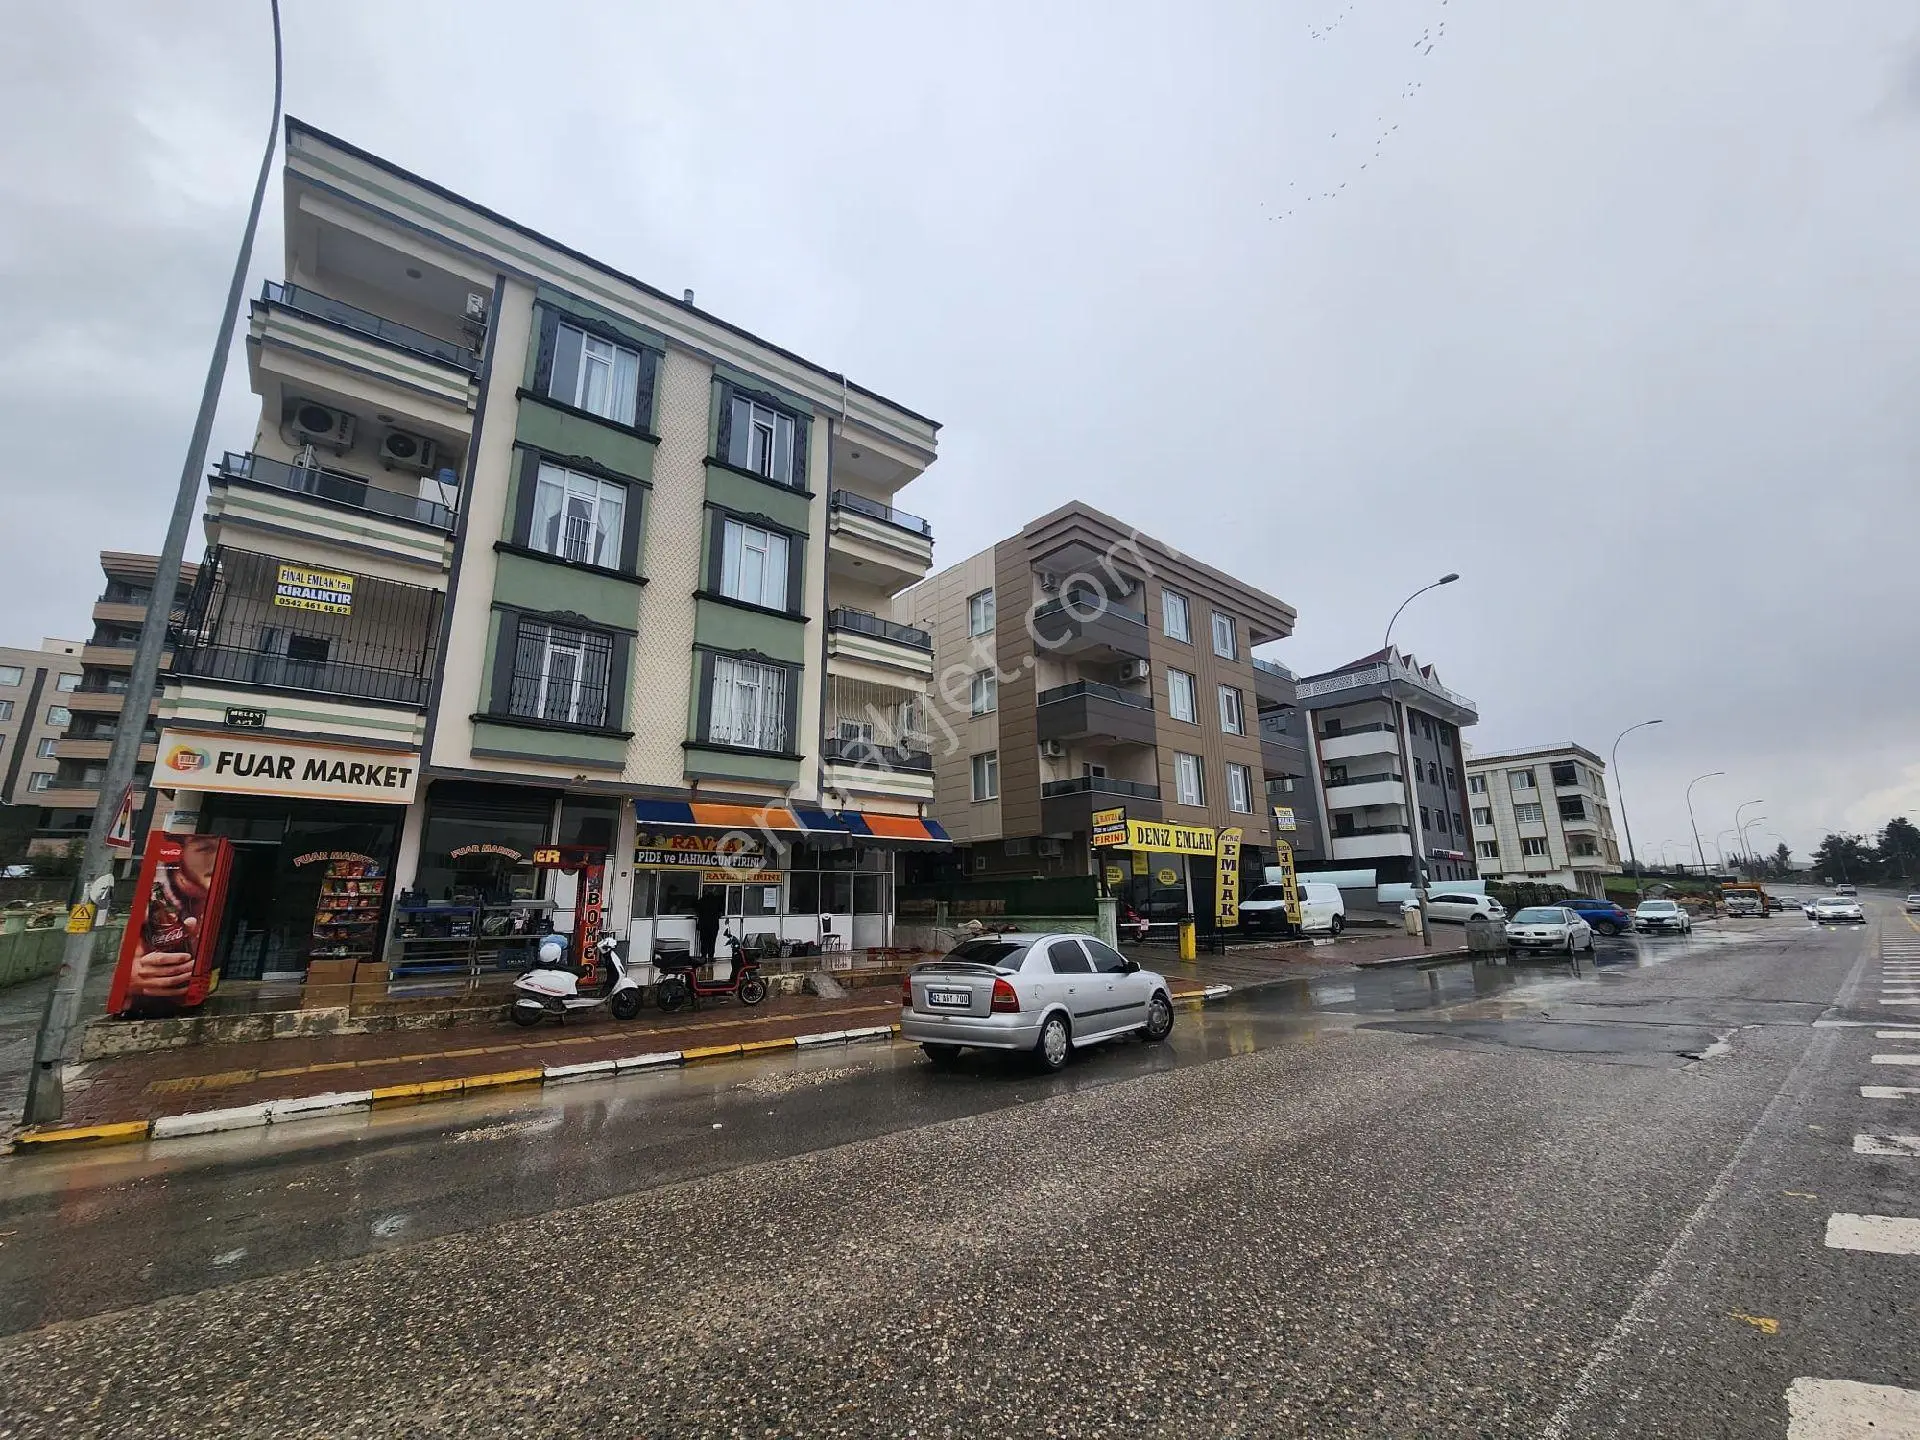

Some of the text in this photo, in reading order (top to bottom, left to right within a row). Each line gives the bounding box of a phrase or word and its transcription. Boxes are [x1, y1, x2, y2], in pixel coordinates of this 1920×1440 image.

[277, 584, 352, 604] KİRALIKTIR
[279, 598, 302, 606] 0542
[215, 751, 413, 789] FUAR MARKET
[1175, 830, 1213, 850] EMLAK
[293, 852, 328, 868] FUAR
[450, 844, 480, 859] FUAR
[664, 854, 677, 864] ve
[678, 853, 731, 867] LAHMACUN
[1220, 845, 1236, 916] EMLAK
